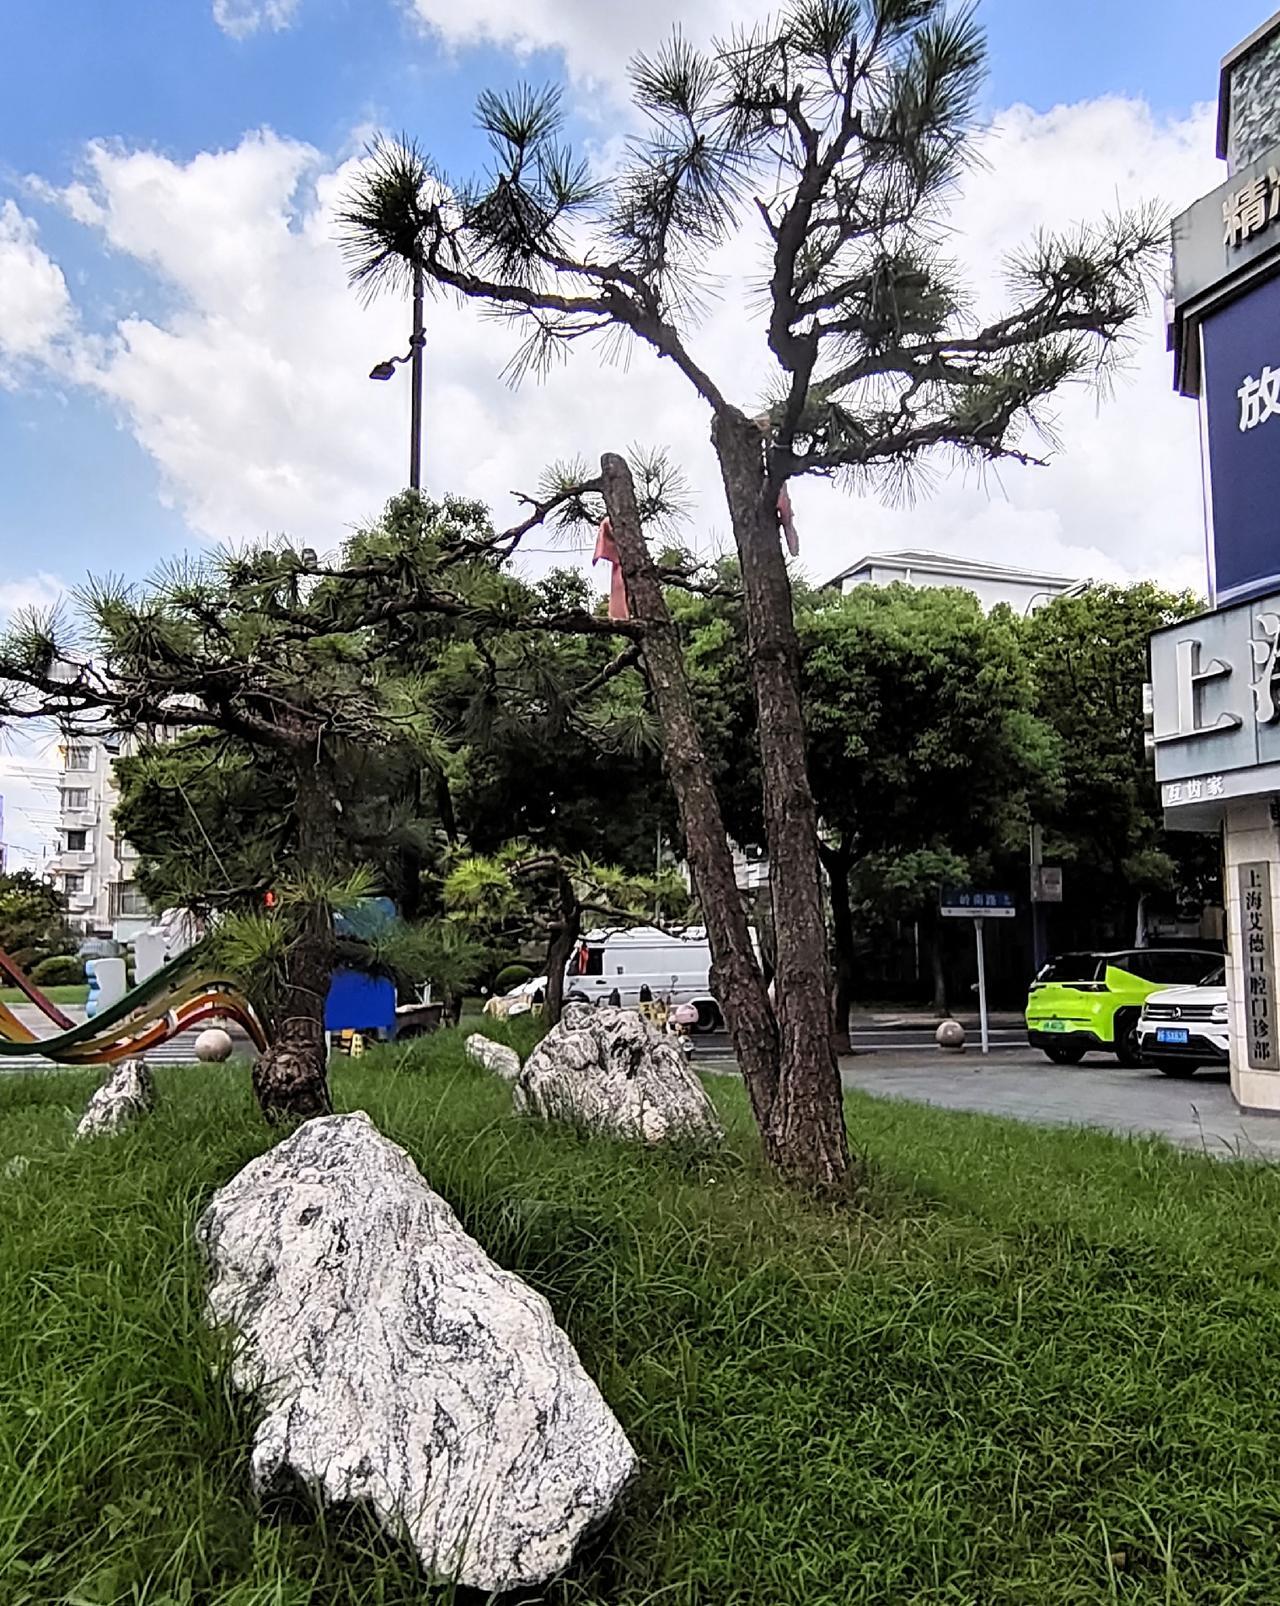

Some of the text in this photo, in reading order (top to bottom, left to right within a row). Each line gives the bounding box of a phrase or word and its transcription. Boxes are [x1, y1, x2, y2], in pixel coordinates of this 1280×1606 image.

[1245, 869, 1271, 1061] 上海艾德口腔门诊部
